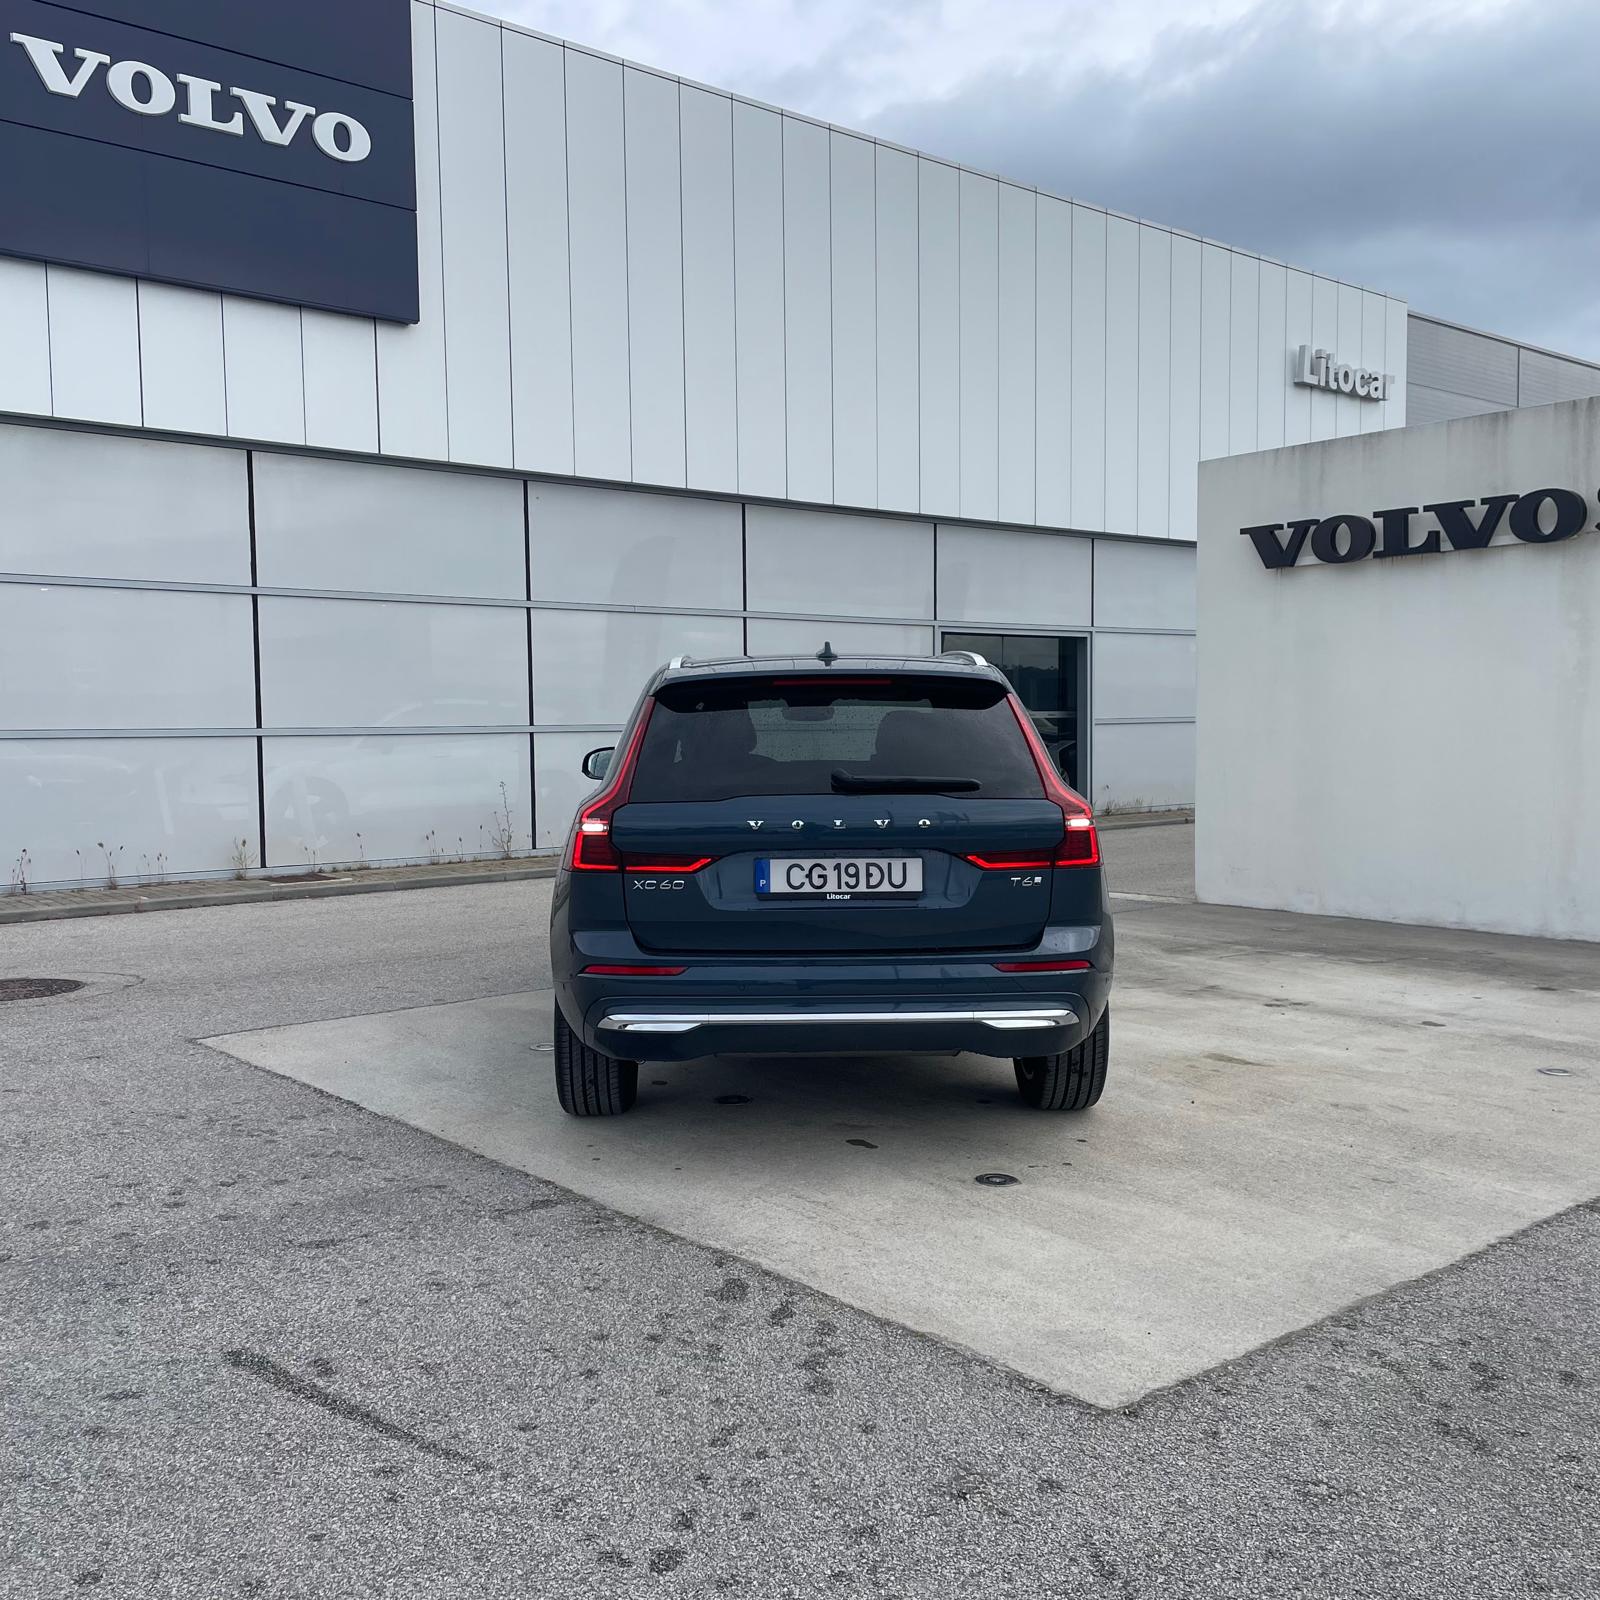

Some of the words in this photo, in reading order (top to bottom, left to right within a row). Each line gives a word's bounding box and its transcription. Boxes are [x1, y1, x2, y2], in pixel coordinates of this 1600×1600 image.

[9, 32, 372, 163] VOLVO
[1295, 344, 1395, 401] Litocar
[1239, 488, 1588, 569] VOLVO
[746, 818, 932, 830] VOLVO
[759, 878, 767, 888] P
